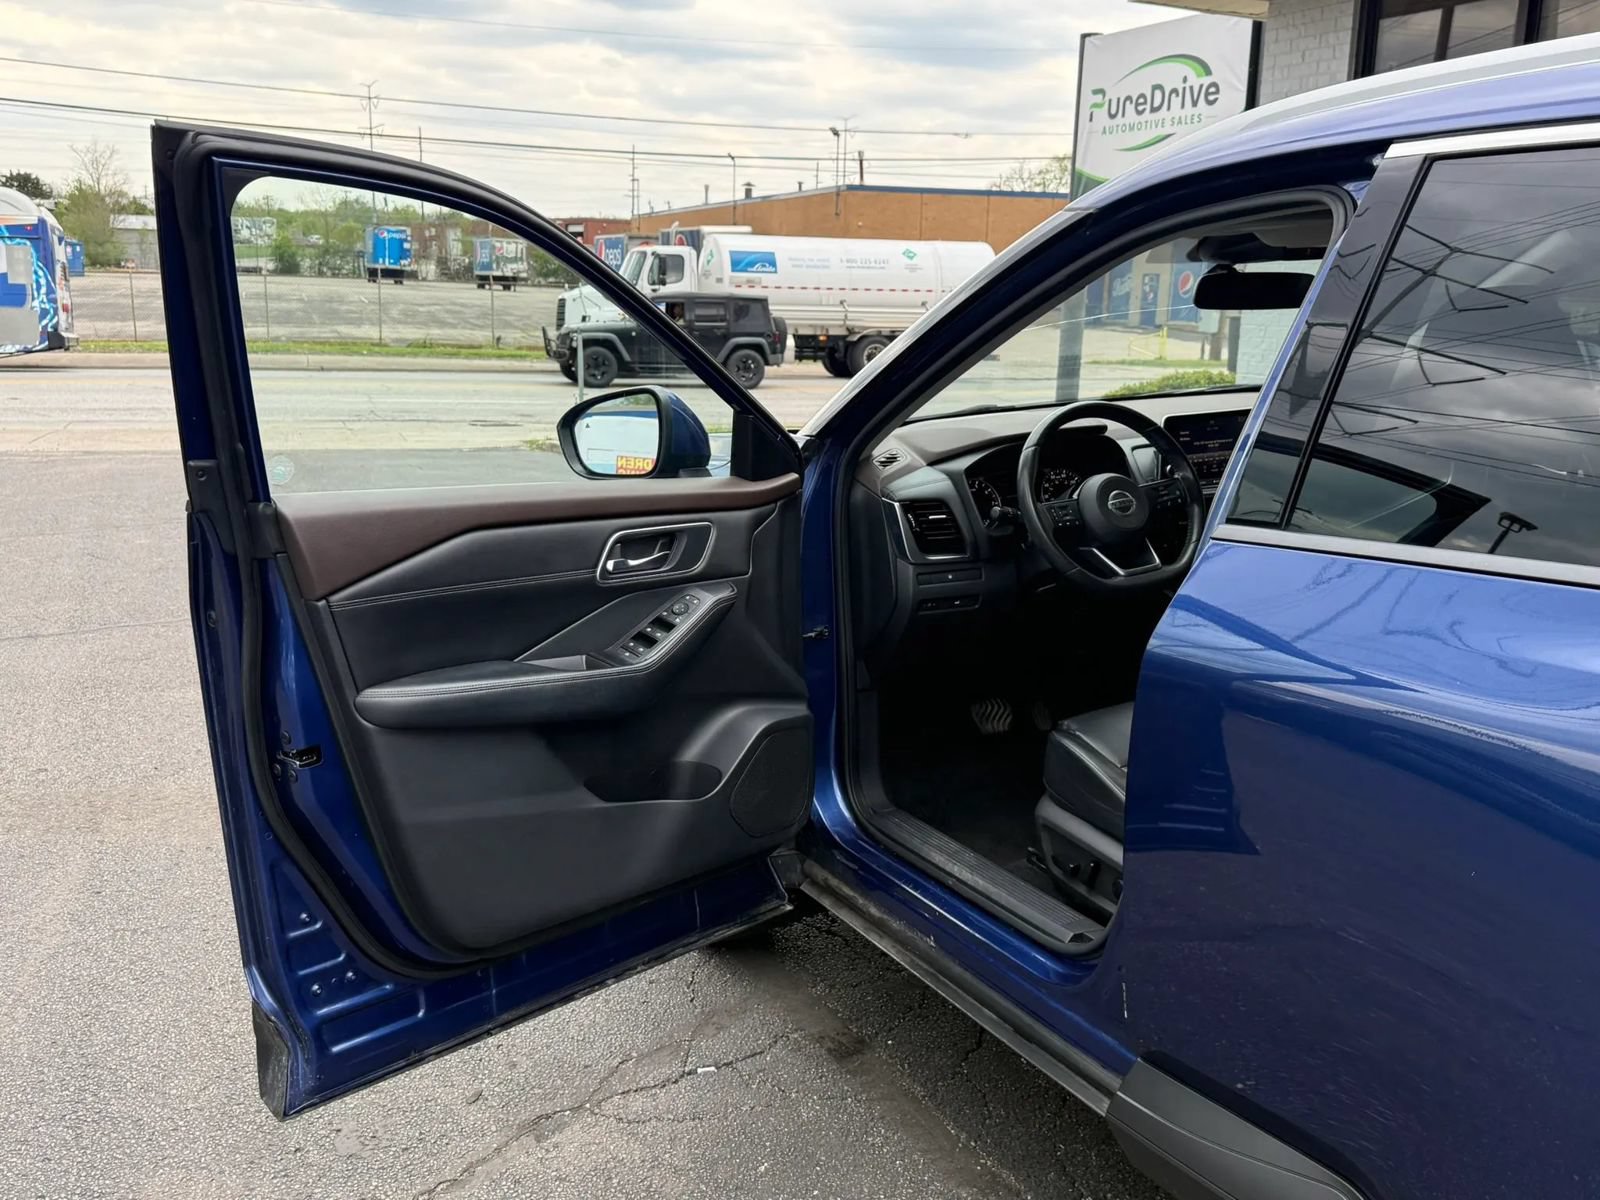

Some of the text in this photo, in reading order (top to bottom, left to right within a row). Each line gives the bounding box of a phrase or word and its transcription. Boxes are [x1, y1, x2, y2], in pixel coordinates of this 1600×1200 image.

[1089, 76, 1220, 123] PureDrive
[1101, 114, 1203, 136] AUTOMOTIVE SALES
